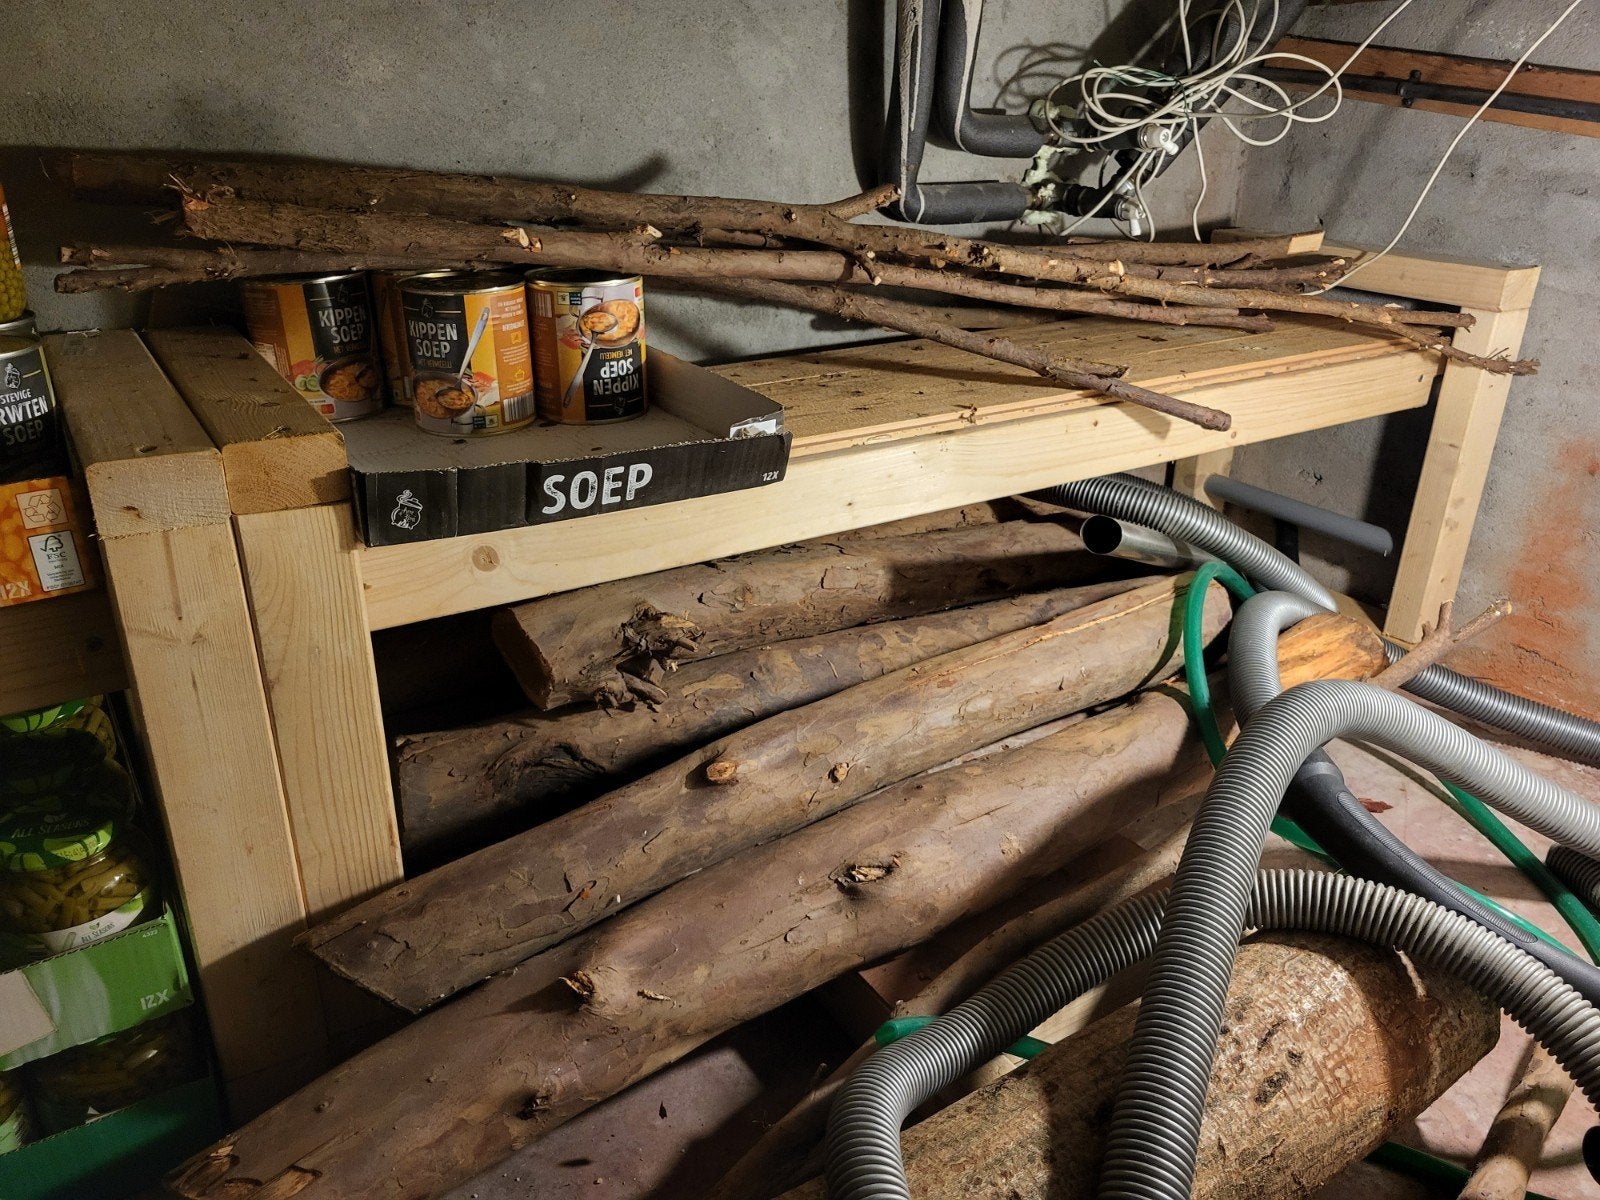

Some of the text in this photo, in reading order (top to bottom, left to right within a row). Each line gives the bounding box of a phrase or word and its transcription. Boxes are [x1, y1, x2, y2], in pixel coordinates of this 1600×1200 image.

[318, 304, 366, 327] KIPPEN
[331, 324, 364, 344] SOEP
[408, 320, 458, 341] KIPPEN
[416, 338, 451, 359] SOEP
[600, 357, 634, 378] SOEP
[593, 373, 639, 396] KIPPEN
[0, 388, 32, 404] STEVIGE
[3, 419, 44, 446] SOEP
[762, 470, 779, 482] 12X
[542, 463, 653, 515] SOEP
[47, 551, 67, 560] FSC
[140, 989, 170, 1010] 12X
